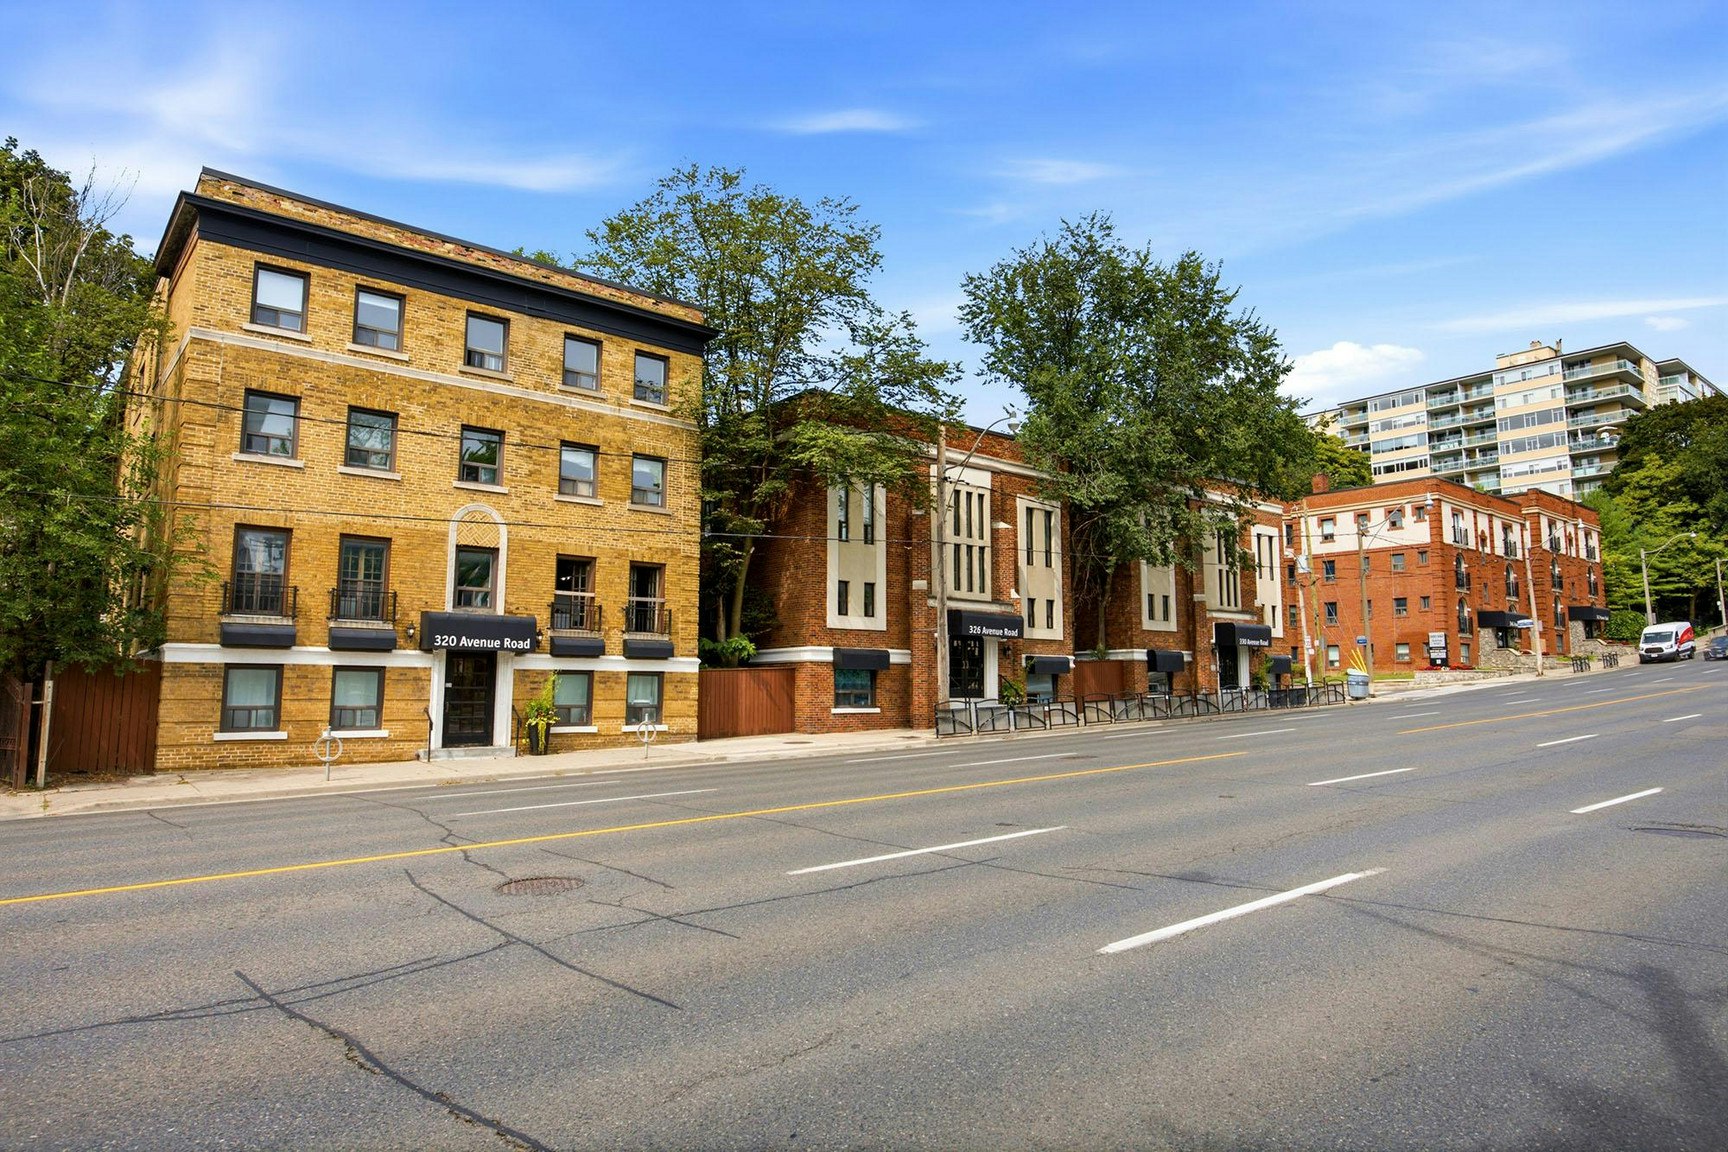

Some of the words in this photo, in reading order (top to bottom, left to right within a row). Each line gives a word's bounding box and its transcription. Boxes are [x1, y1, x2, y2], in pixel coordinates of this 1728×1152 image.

[969, 626, 981, 634] 326
[982, 626, 1003, 636] Avenue
[1004, 628, 1018, 636] Road
[434, 635, 457, 647] 320
[459, 636, 501, 648] Avenue
[504, 638, 531, 649] Road
